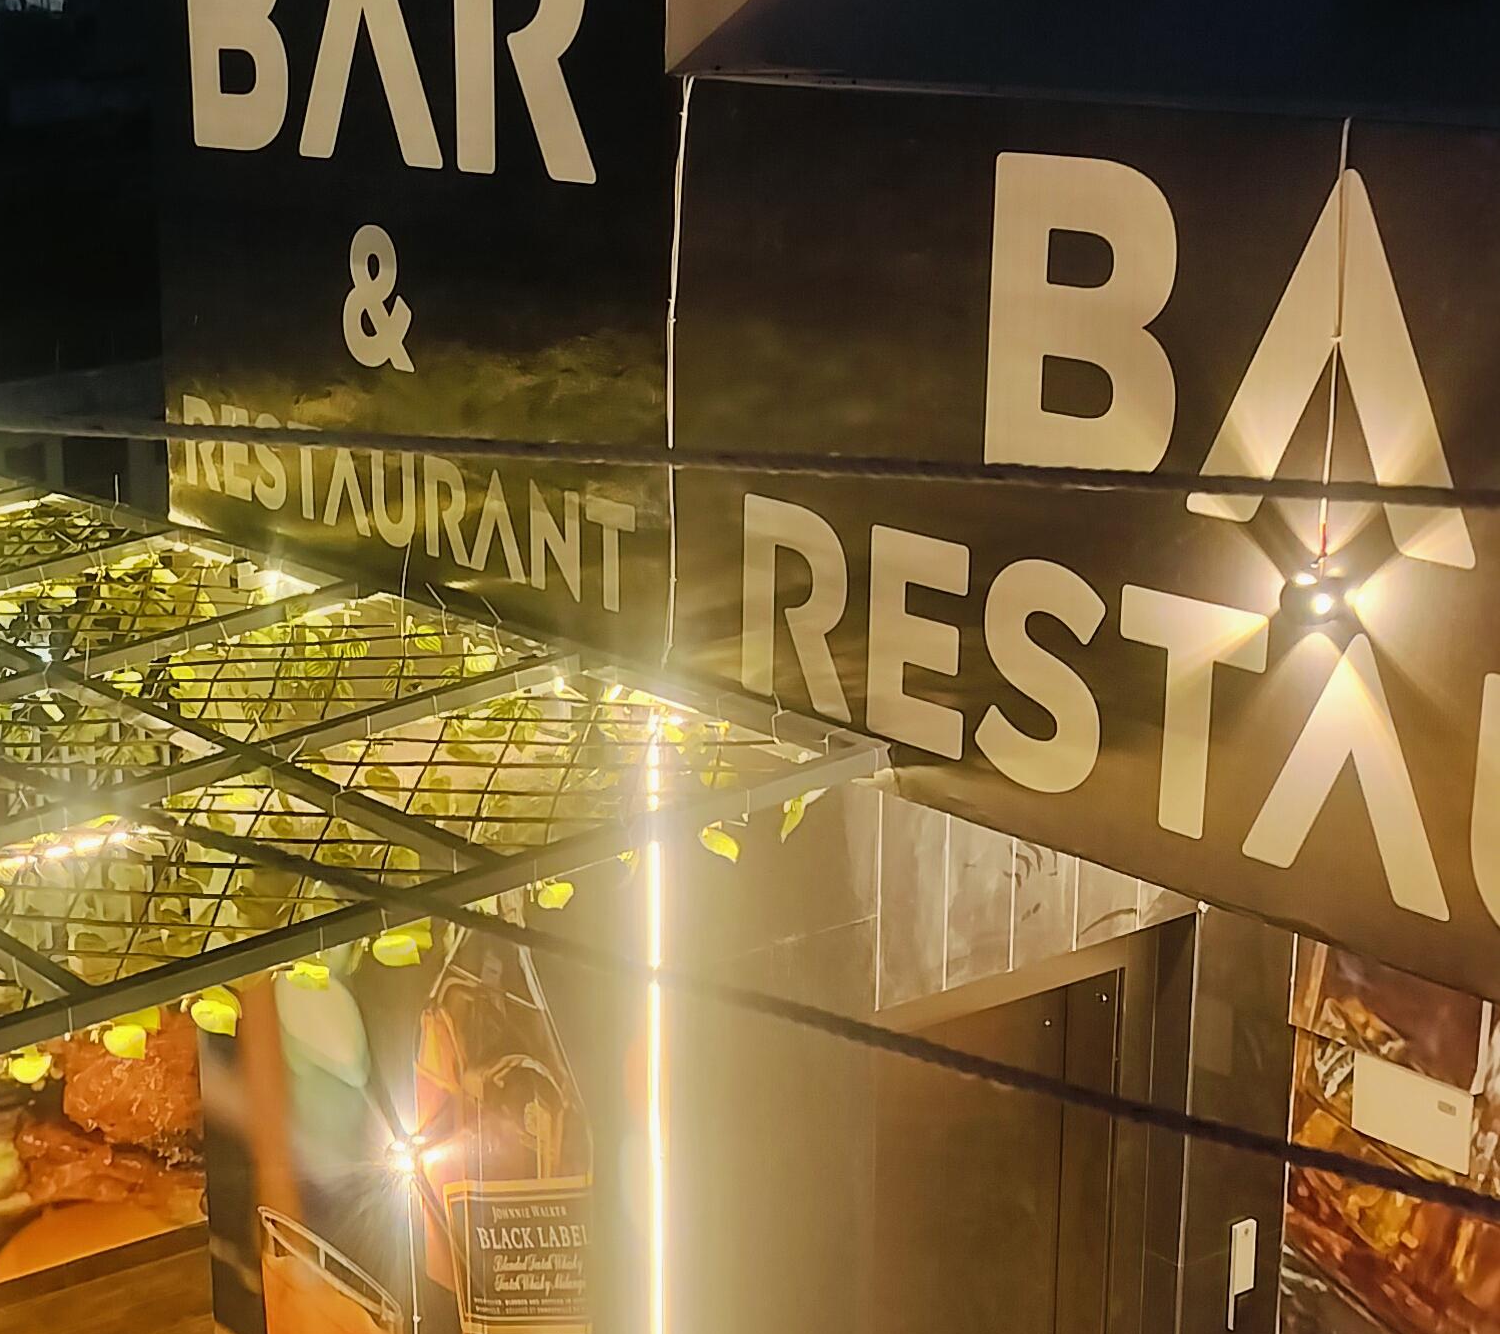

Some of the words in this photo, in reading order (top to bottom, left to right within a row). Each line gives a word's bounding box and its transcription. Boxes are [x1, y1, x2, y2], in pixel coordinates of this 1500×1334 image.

[342, 224, 415, 373] &
[182, 394, 636, 613] RESTAURANT
[740, 492, 1500, 929] RESTA
[476, 1226, 535, 1250] BLACK
